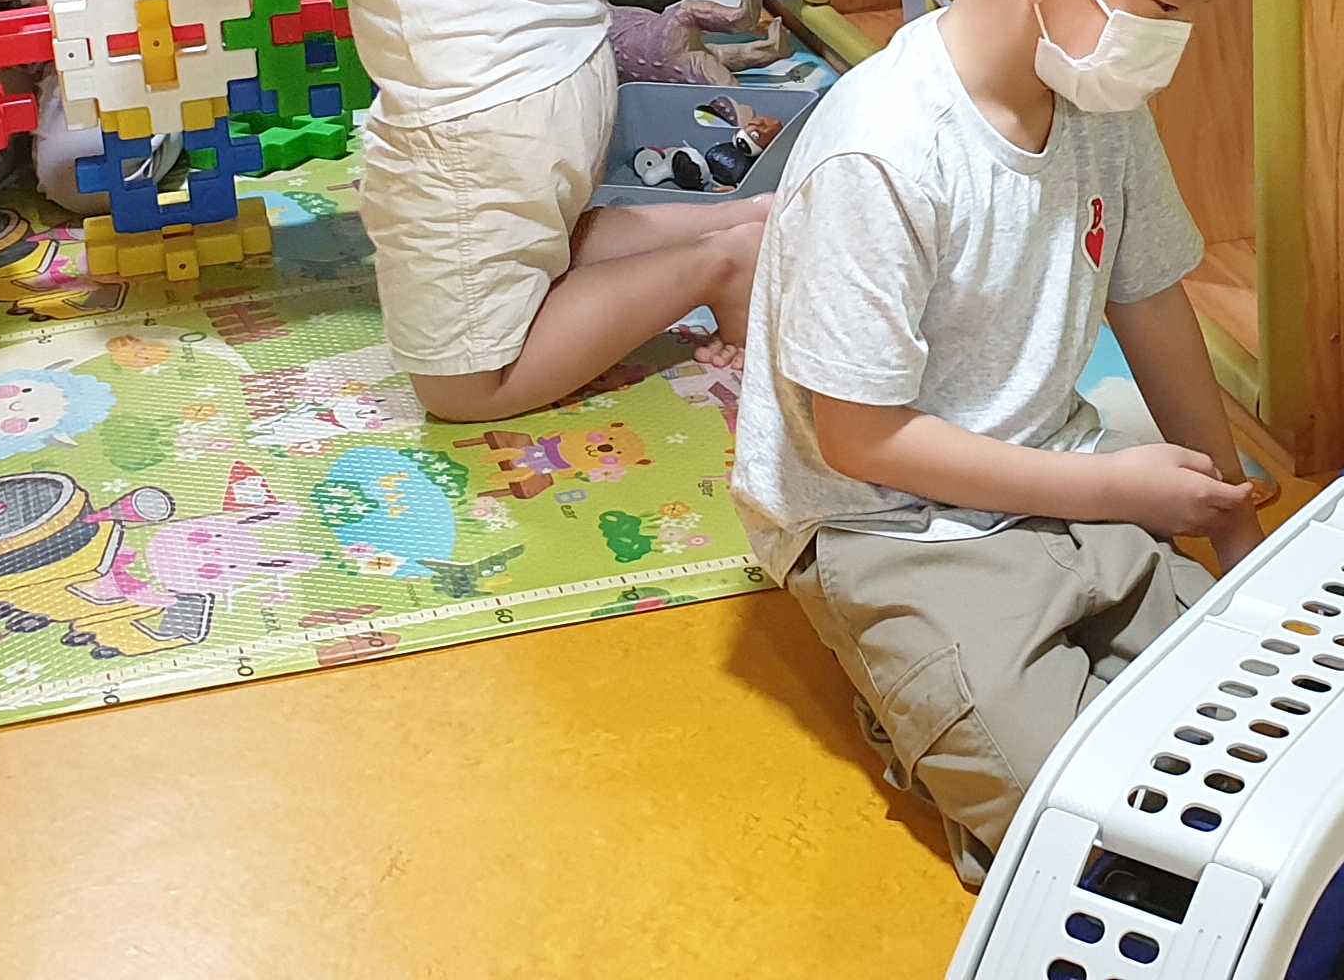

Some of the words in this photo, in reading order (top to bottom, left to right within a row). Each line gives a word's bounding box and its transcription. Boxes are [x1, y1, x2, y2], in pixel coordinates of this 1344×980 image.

[555, 489, 588, 520] Bear
[743, 566, 764, 583] 80
[623, 586, 640, 601] 70
[495, 608, 514, 624] 60
[237, 657, 255, 677] 40
